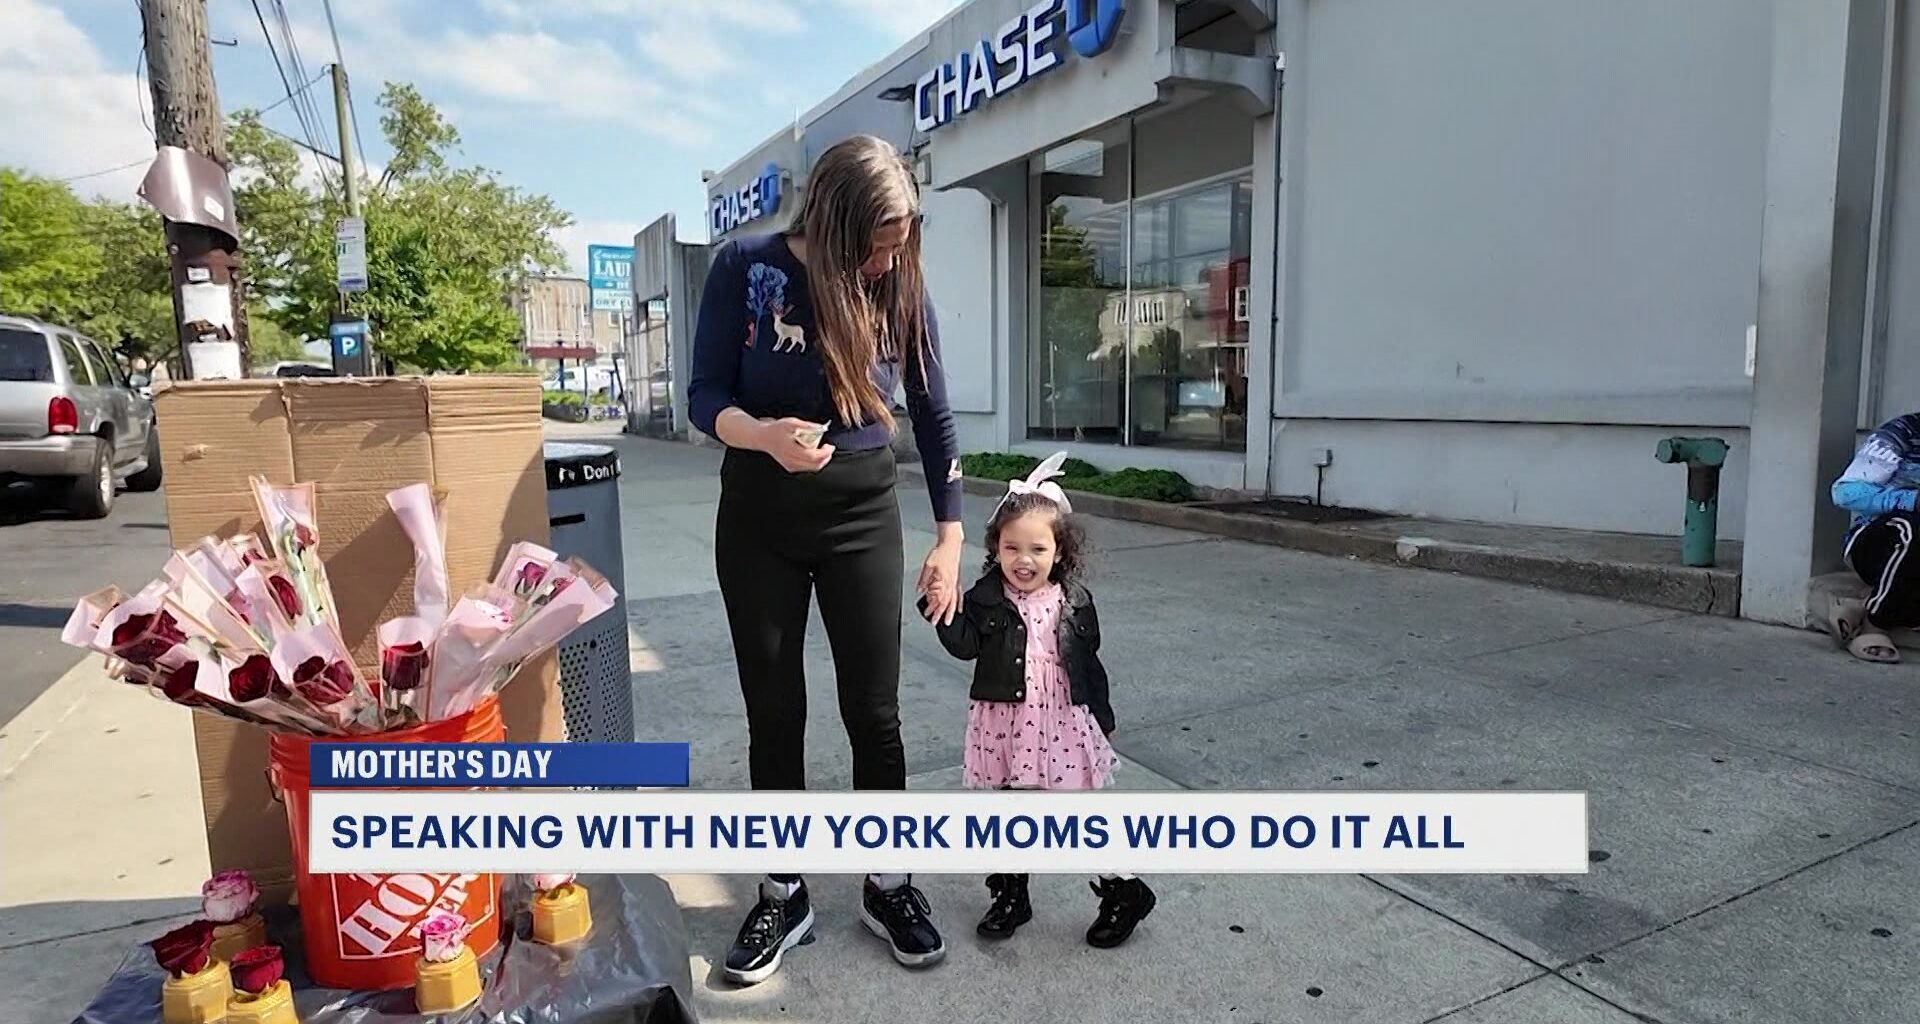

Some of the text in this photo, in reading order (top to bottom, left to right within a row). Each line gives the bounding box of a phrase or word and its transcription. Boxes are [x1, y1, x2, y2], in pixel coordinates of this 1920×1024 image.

[914, 0, 1067, 133] CHASE
[711, 176, 762, 237] CHASE
[341, 336, 356, 356] P
